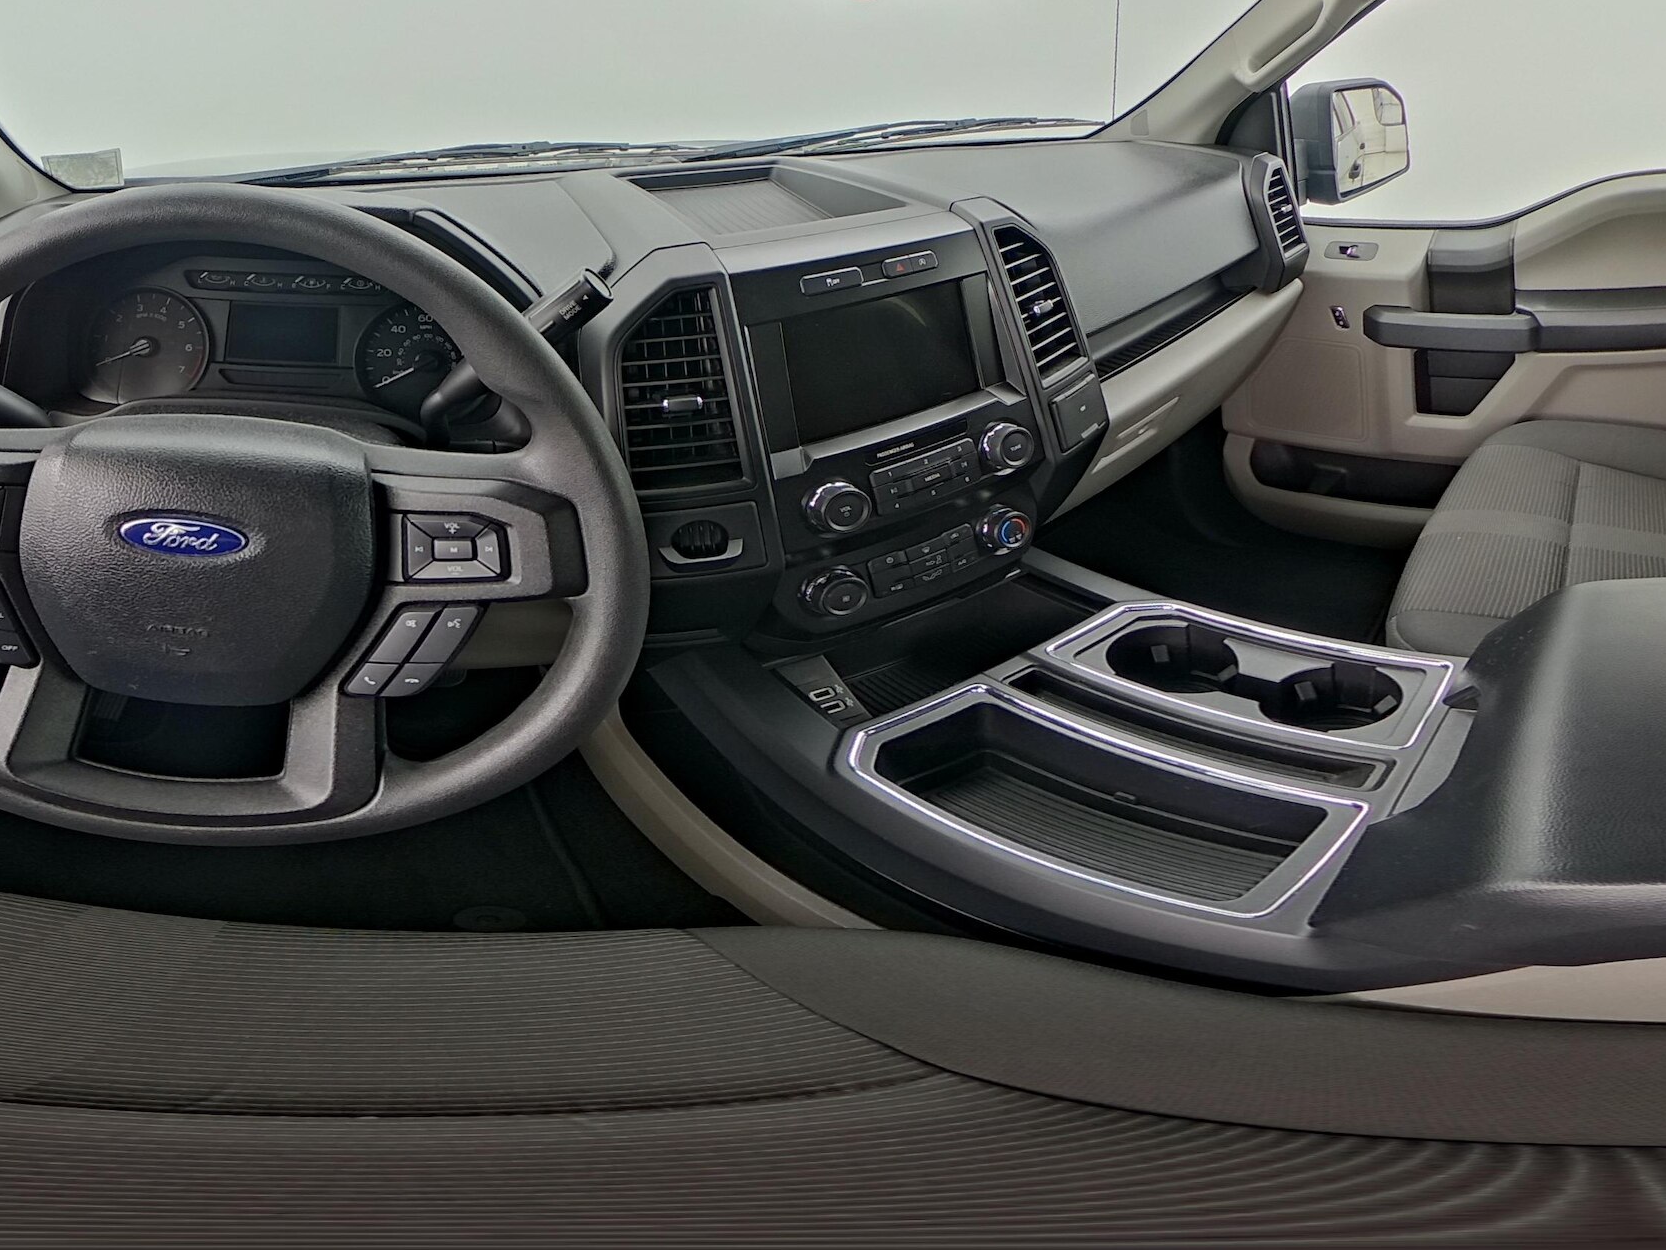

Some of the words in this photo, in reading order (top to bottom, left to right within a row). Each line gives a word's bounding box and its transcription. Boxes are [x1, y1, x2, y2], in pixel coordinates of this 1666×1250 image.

[137, 304, 143, 312] 3
[160, 306, 167, 314] 4
[559, 299, 577, 315] DRIVE
[563, 305, 582, 321] MODE
[116, 314, 123, 323] 2
[417, 314, 434, 323] 60
[177, 321, 185, 329] 5
[390, 325, 407, 334] 40
[185, 343, 193, 352] 6
[376, 349, 392, 358] 20
[178, 365, 185, 373] 7
[899, 442, 915, 452] AIRBAG
[142, 521, 220, 552] Ford
[447, 565, 464, 573] VOL
[1, 644, 18, 652] OFF
